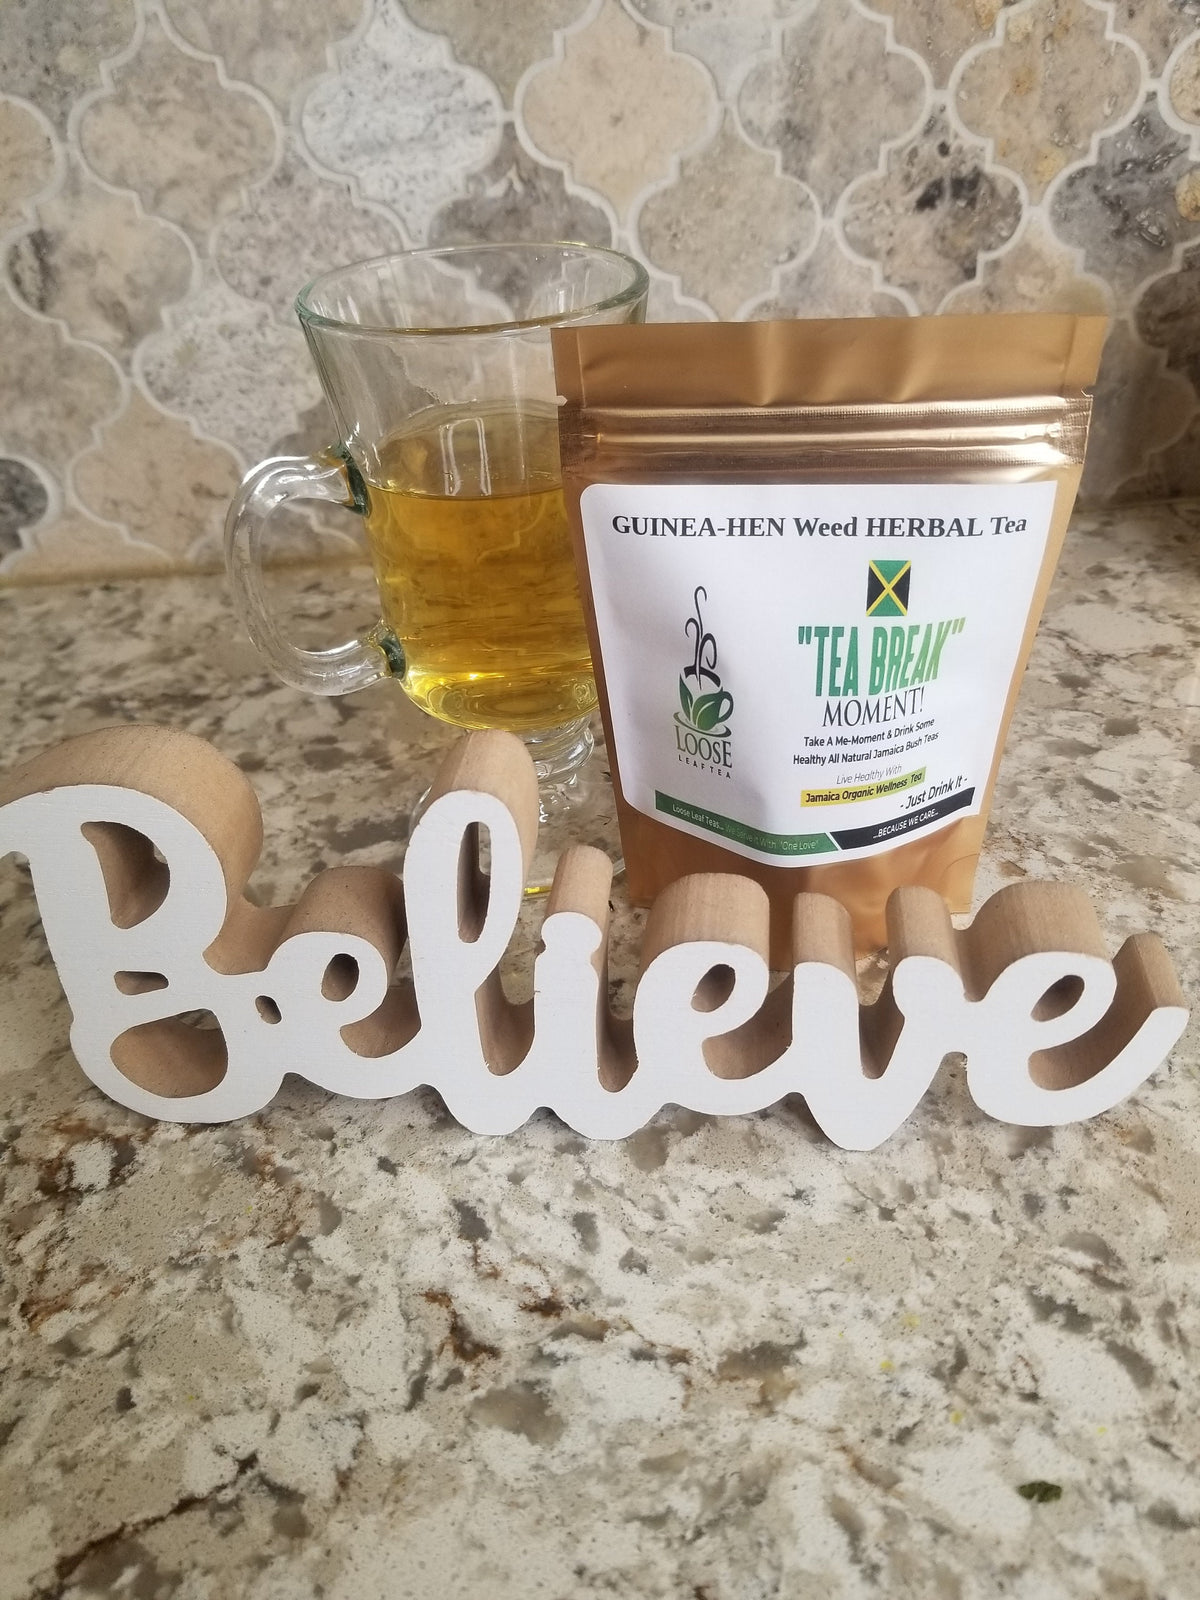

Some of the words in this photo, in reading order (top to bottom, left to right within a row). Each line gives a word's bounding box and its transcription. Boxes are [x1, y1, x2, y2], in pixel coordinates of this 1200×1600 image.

[611, 514, 786, 537] GUINEA-HEN
[793, 515, 858, 537] Weed
[865, 516, 983, 538] HERBAL
[990, 515, 1027, 536] Tea
[822, 686, 925, 727] MOMENT!
[674, 724, 732, 768] LOOSE
[804, 736, 825, 747] Take
[826, 735, 833, 746] A
[835, 731, 885, 747] Me-Moment
[886, 729, 893, 739] &
[894, 724, 914, 737] Drink
[915, 718, 935, 732] Some
[793, 754, 826, 766] Healthy
[828, 752, 839, 764] All
[841, 750, 872, 764] Natural
[873, 744, 904, 759] Jamaica
[905, 738, 923, 751] Bush
[924, 731, 939, 744] Teas
[805, 791, 840, 803] Jamaica
[842, 786, 874, 801] Organic
[876, 779, 907, 794] Wellness
[910, 773, 923, 784] Tea
[836, 774, 853, 785] Live
[853, 767, 884, 784] Healthy
[885, 764, 902, 776] With
[906, 793, 926, 810] Just
[928, 779, 955, 801] Drink
[956, 775, 964, 789] It
[672, 804, 691, 818] Loose
[691, 812, 706, 823] Leaf
[908, 815, 920, 825] WE
[0, 783, 1190, 1151] Believe
